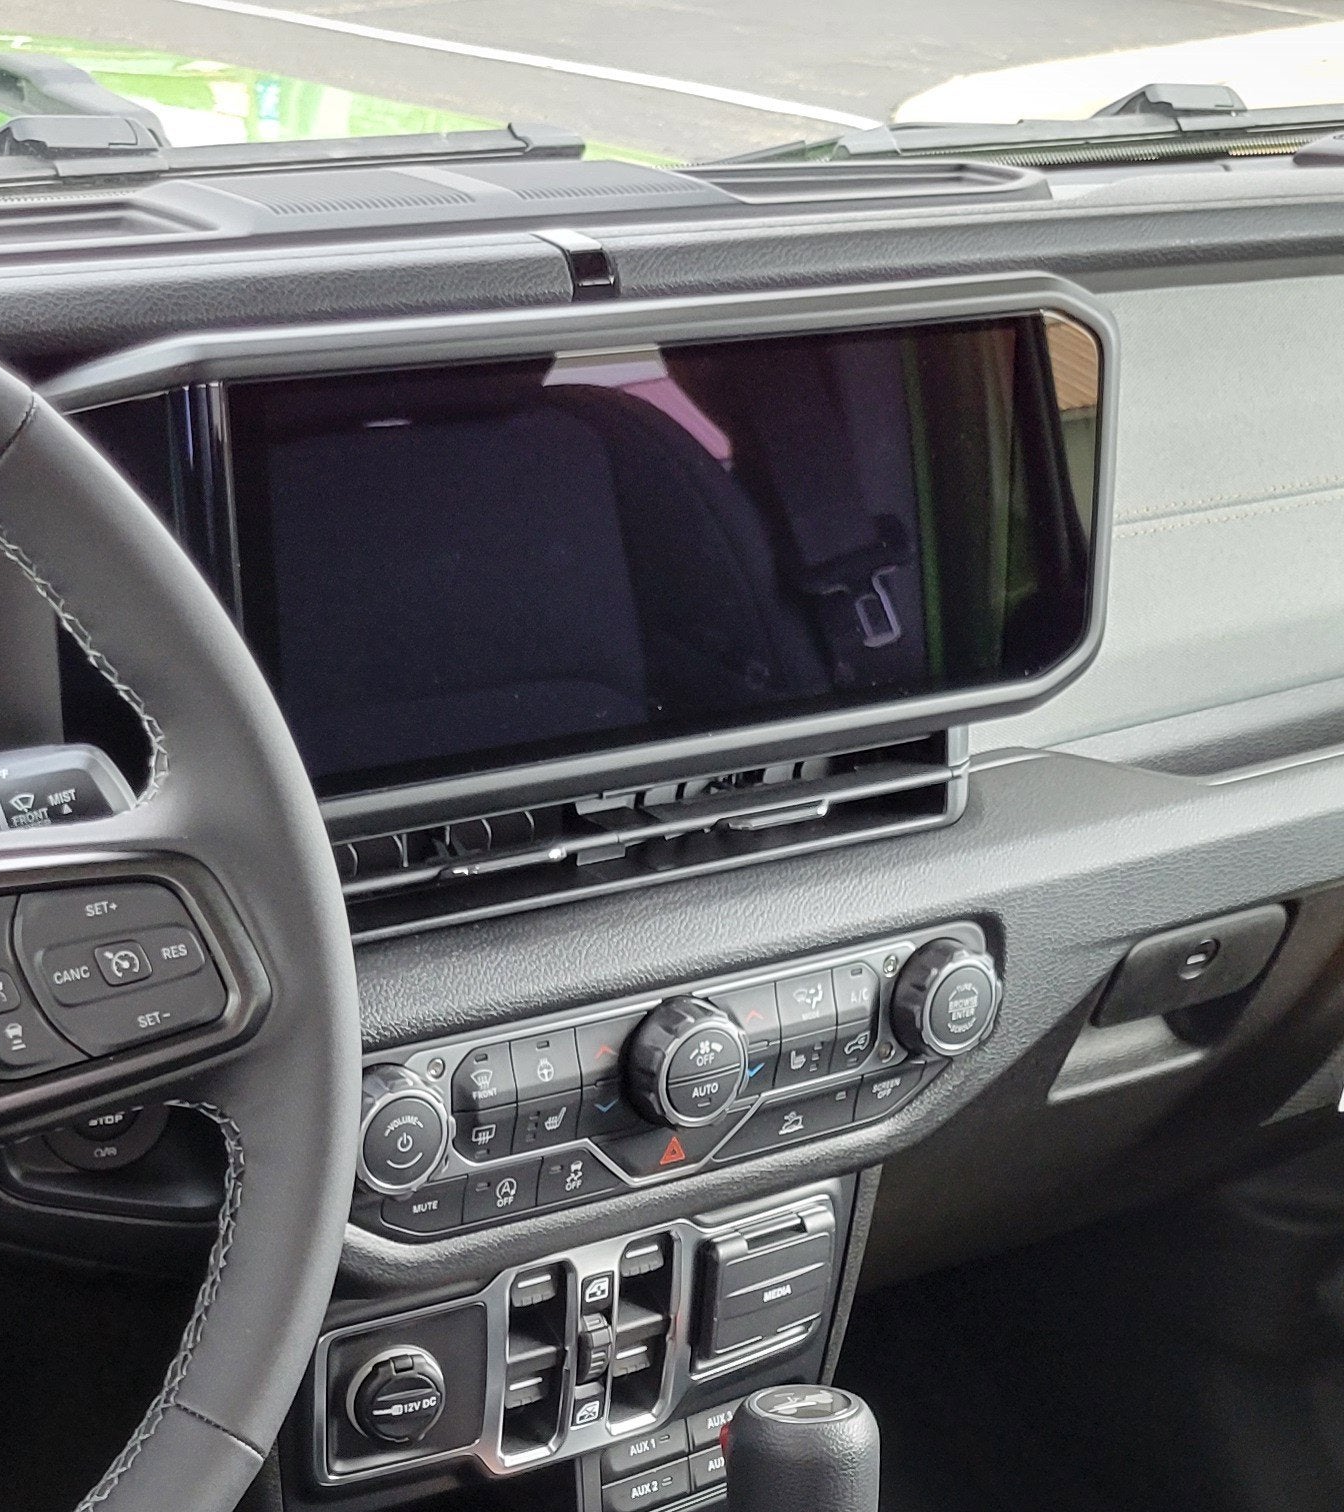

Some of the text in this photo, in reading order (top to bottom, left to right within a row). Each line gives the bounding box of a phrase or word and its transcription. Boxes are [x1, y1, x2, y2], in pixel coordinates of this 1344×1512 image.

[47, 788, 77, 807] MIST
[10, 808, 49, 828] FRONT
[161, 944, 188, 961] RES
[53, 965, 90, 985] CANC
[850, 987, 869, 1003] A/C
[951, 1008, 975, 1021] ENTER
[696, 1052, 715, 1067] OFF
[472, 1088, 498, 1100] FRONT
[692, 1082, 719, 1099] AUTO
[877, 1087, 893, 1100] OFF
[388, 1115, 419, 1133] VOLUME
[565, 1178, 582, 1192] OFF
[412, 1201, 438, 1214] MUTE
[496, 1196, 514, 1208] OFF
[763, 1284, 792, 1303] MEDIA
[404, 1396, 437, 1414] 12V DC
[707, 1415, 725, 1430] AUX
[630, 1440, 650, 1457] AUX
[631, 1480, 659, 1500] AUX 2
